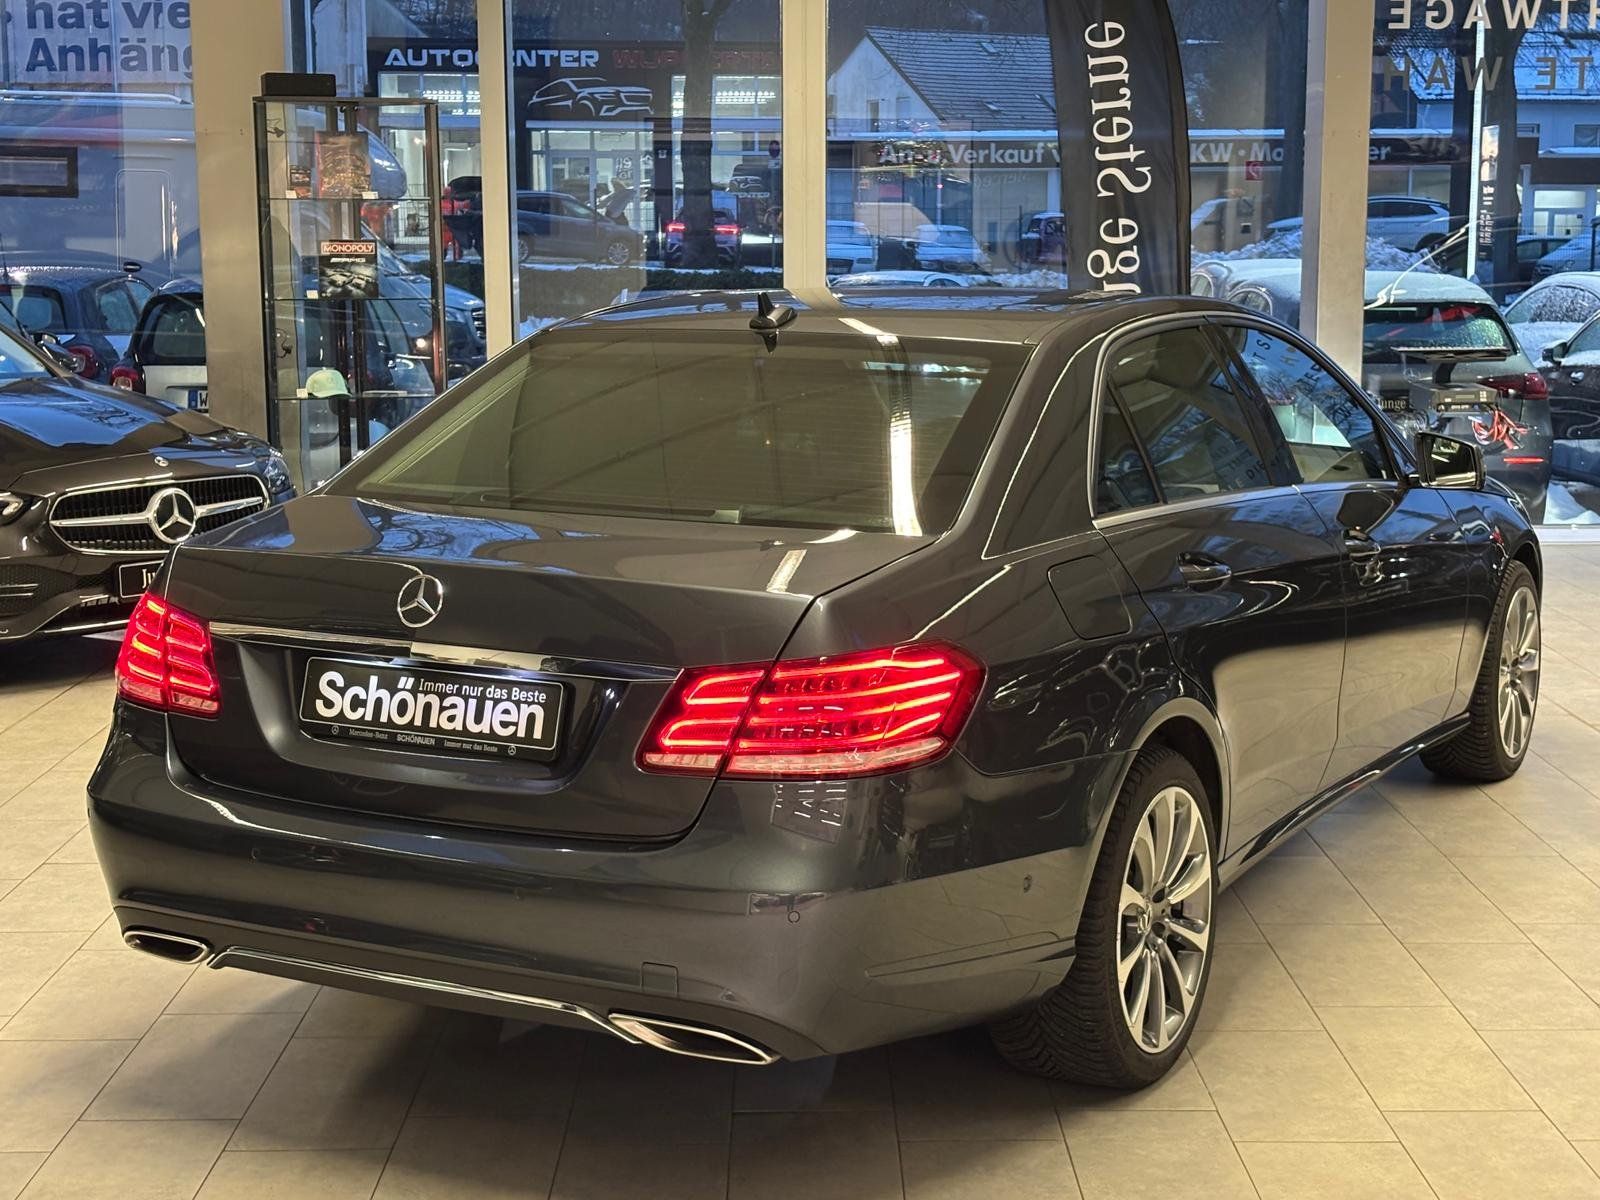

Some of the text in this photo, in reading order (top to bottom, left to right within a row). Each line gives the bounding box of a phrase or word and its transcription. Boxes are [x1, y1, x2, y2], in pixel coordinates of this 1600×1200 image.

[26, 0, 110, 30] hat
[384, 48, 599, 68] AUTONTER
[947, 142, 1046, 164] Verkauf
[323, 244, 373, 252] MONOPOLY
[418, 678, 547, 703] Immer nur das Beste
[315, 670, 546, 740] Schönauen
[348, 728, 436, 746] Mercedes-Benz SCHÖNAUEN
[443, 739, 461, 748] Immer
[473, 742, 483, 750] das
[483, 742, 499, 753] Beste
